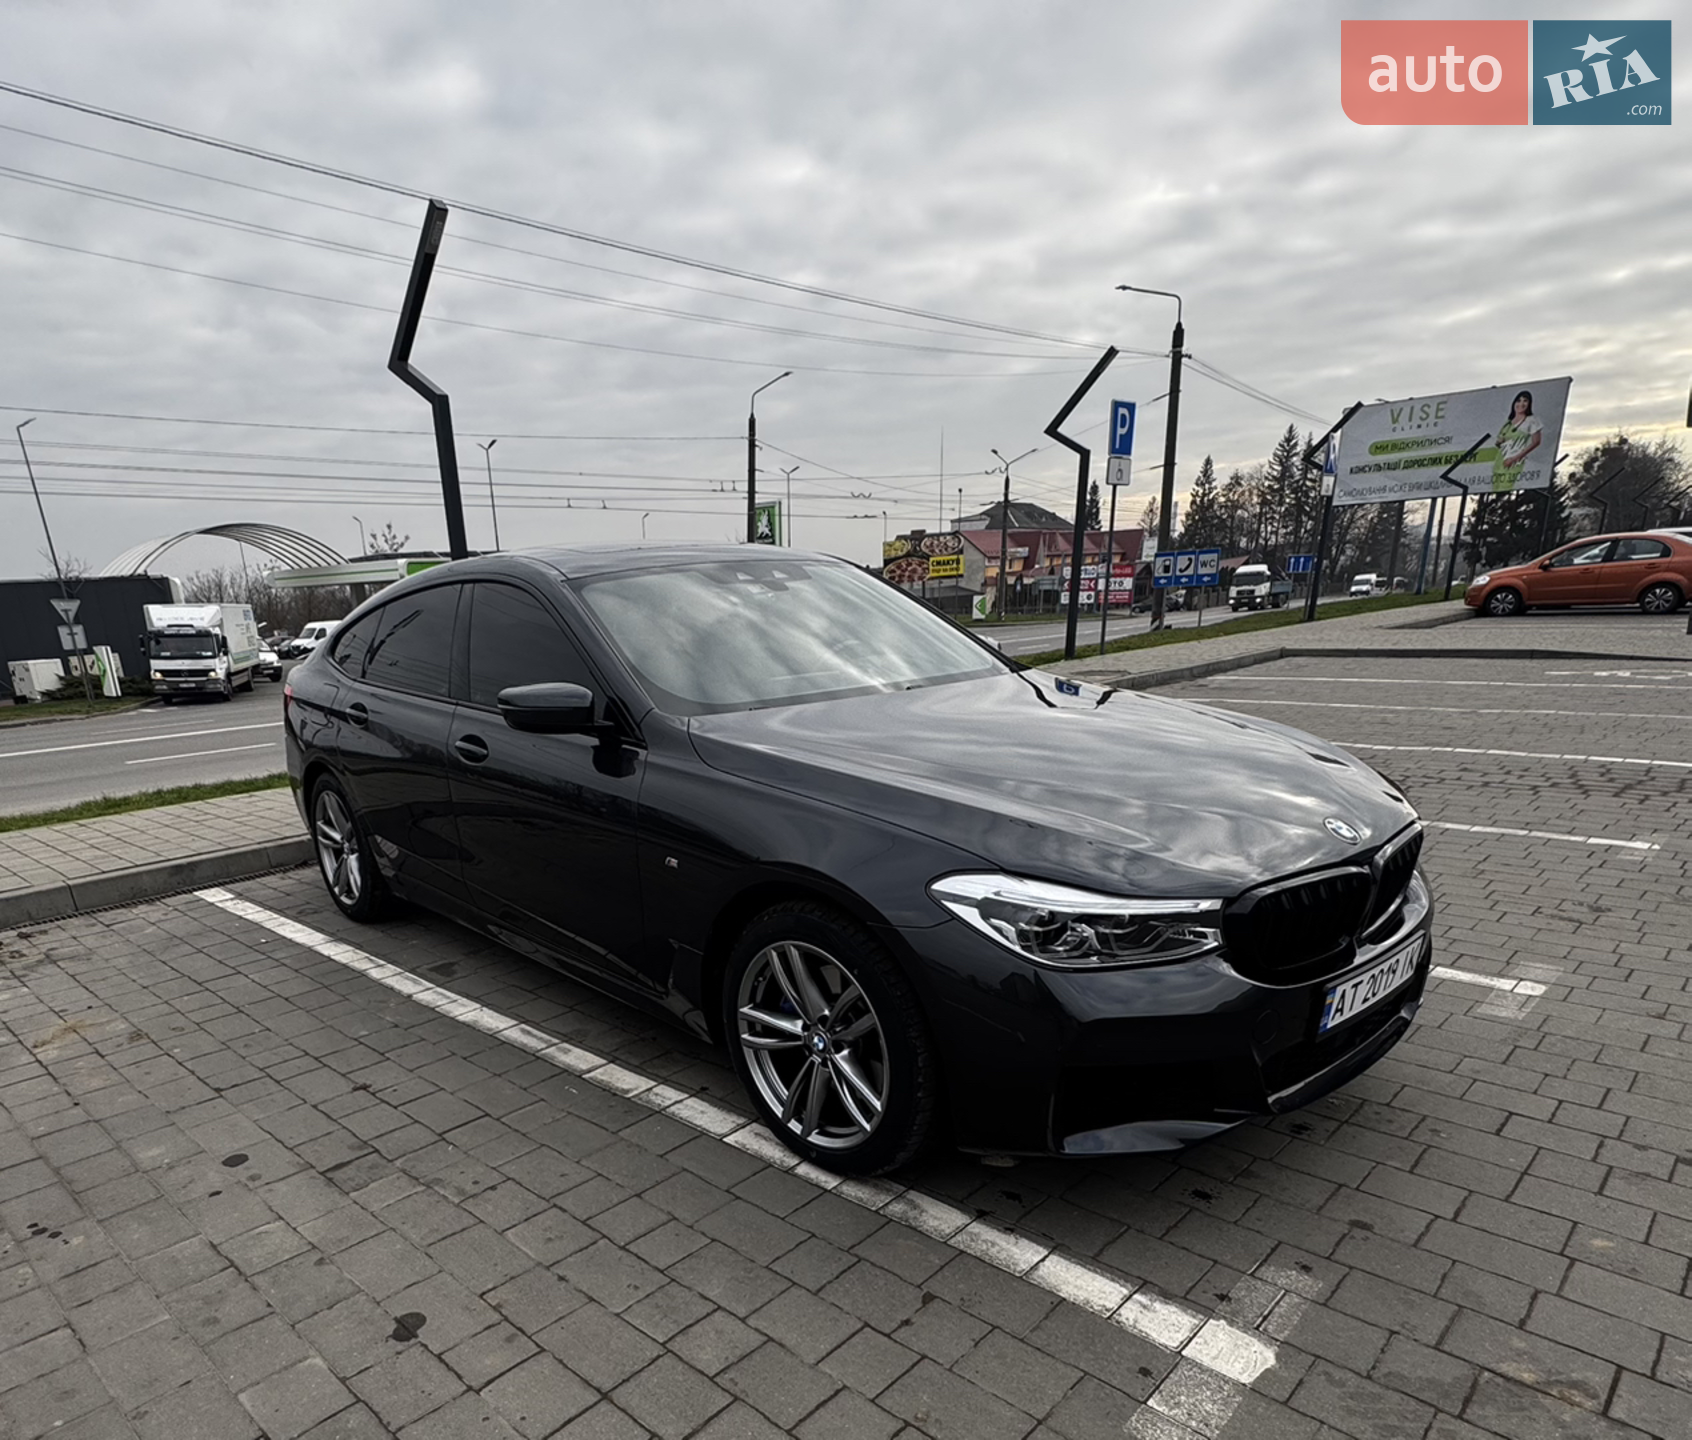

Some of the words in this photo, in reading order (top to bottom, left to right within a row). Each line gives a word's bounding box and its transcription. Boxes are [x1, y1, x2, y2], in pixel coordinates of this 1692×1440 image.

[1115, 407, 1130, 449] P
[1390, 400, 1448, 425] VISE
[1200, 559, 1216, 568] WC
[1331, 979, 1363, 1022] AT
[1361, 958, 1400, 1006] 2019
